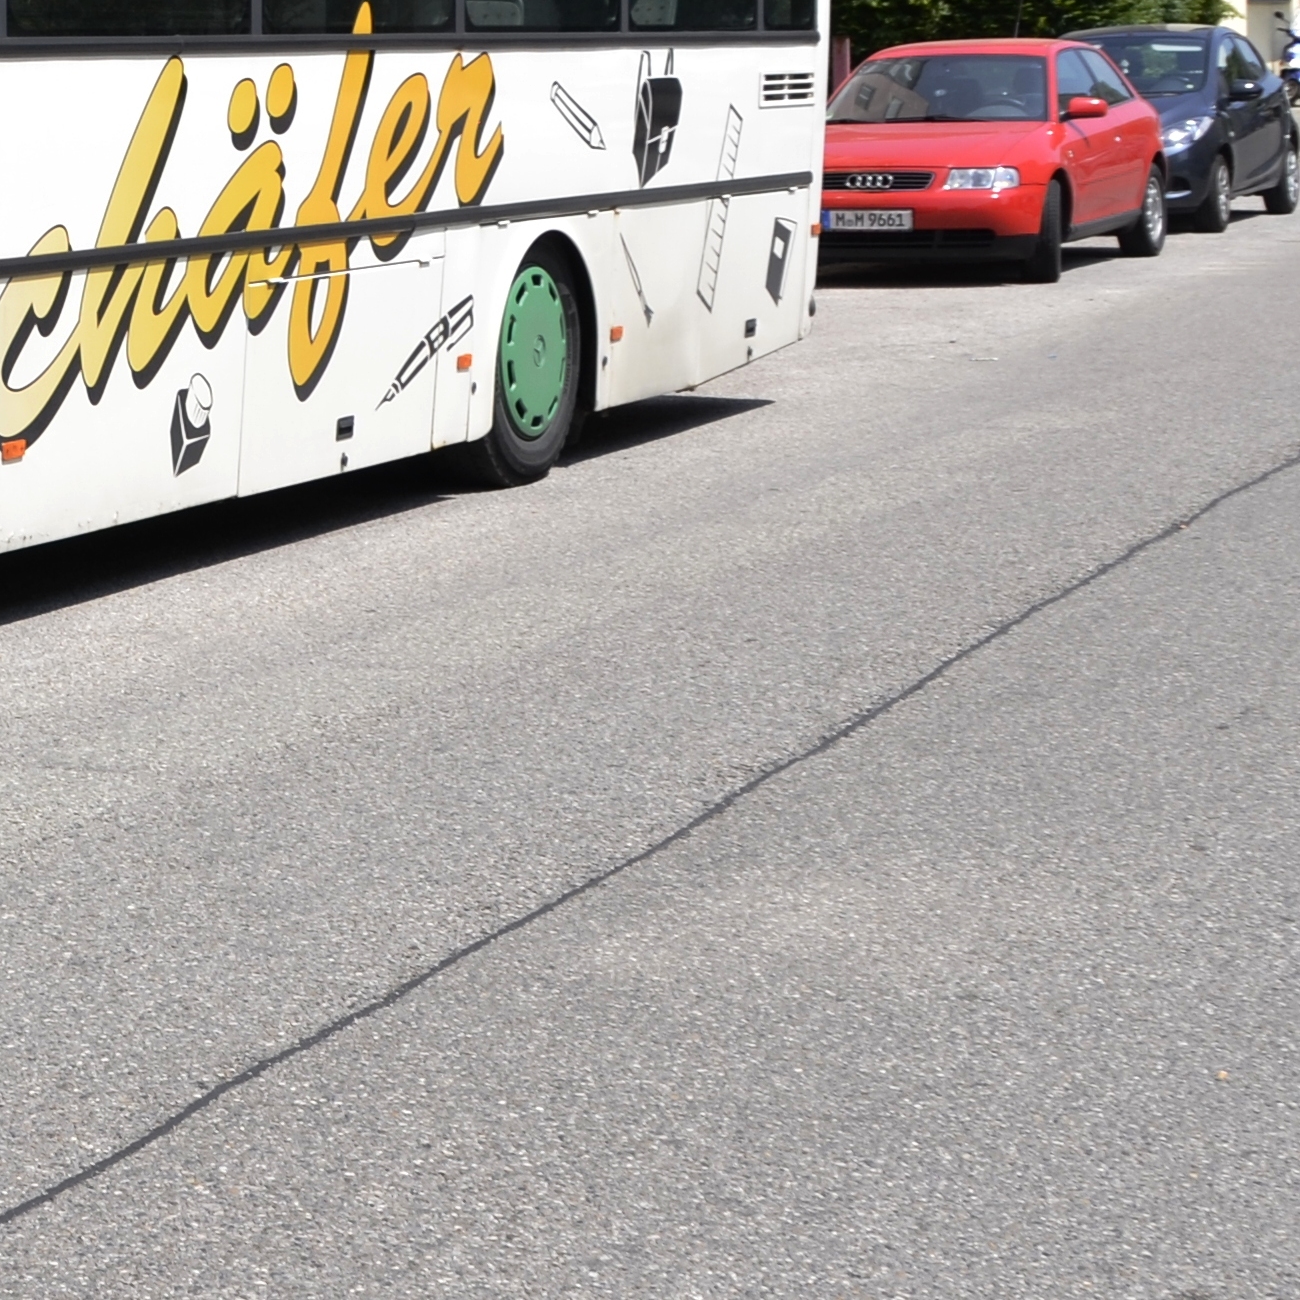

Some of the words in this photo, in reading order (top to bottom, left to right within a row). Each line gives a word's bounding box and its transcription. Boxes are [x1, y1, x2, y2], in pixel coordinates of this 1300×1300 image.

[835, 213, 845, 227] M
[855, 213, 864, 227] M
[868, 213, 905, 227] 9661
